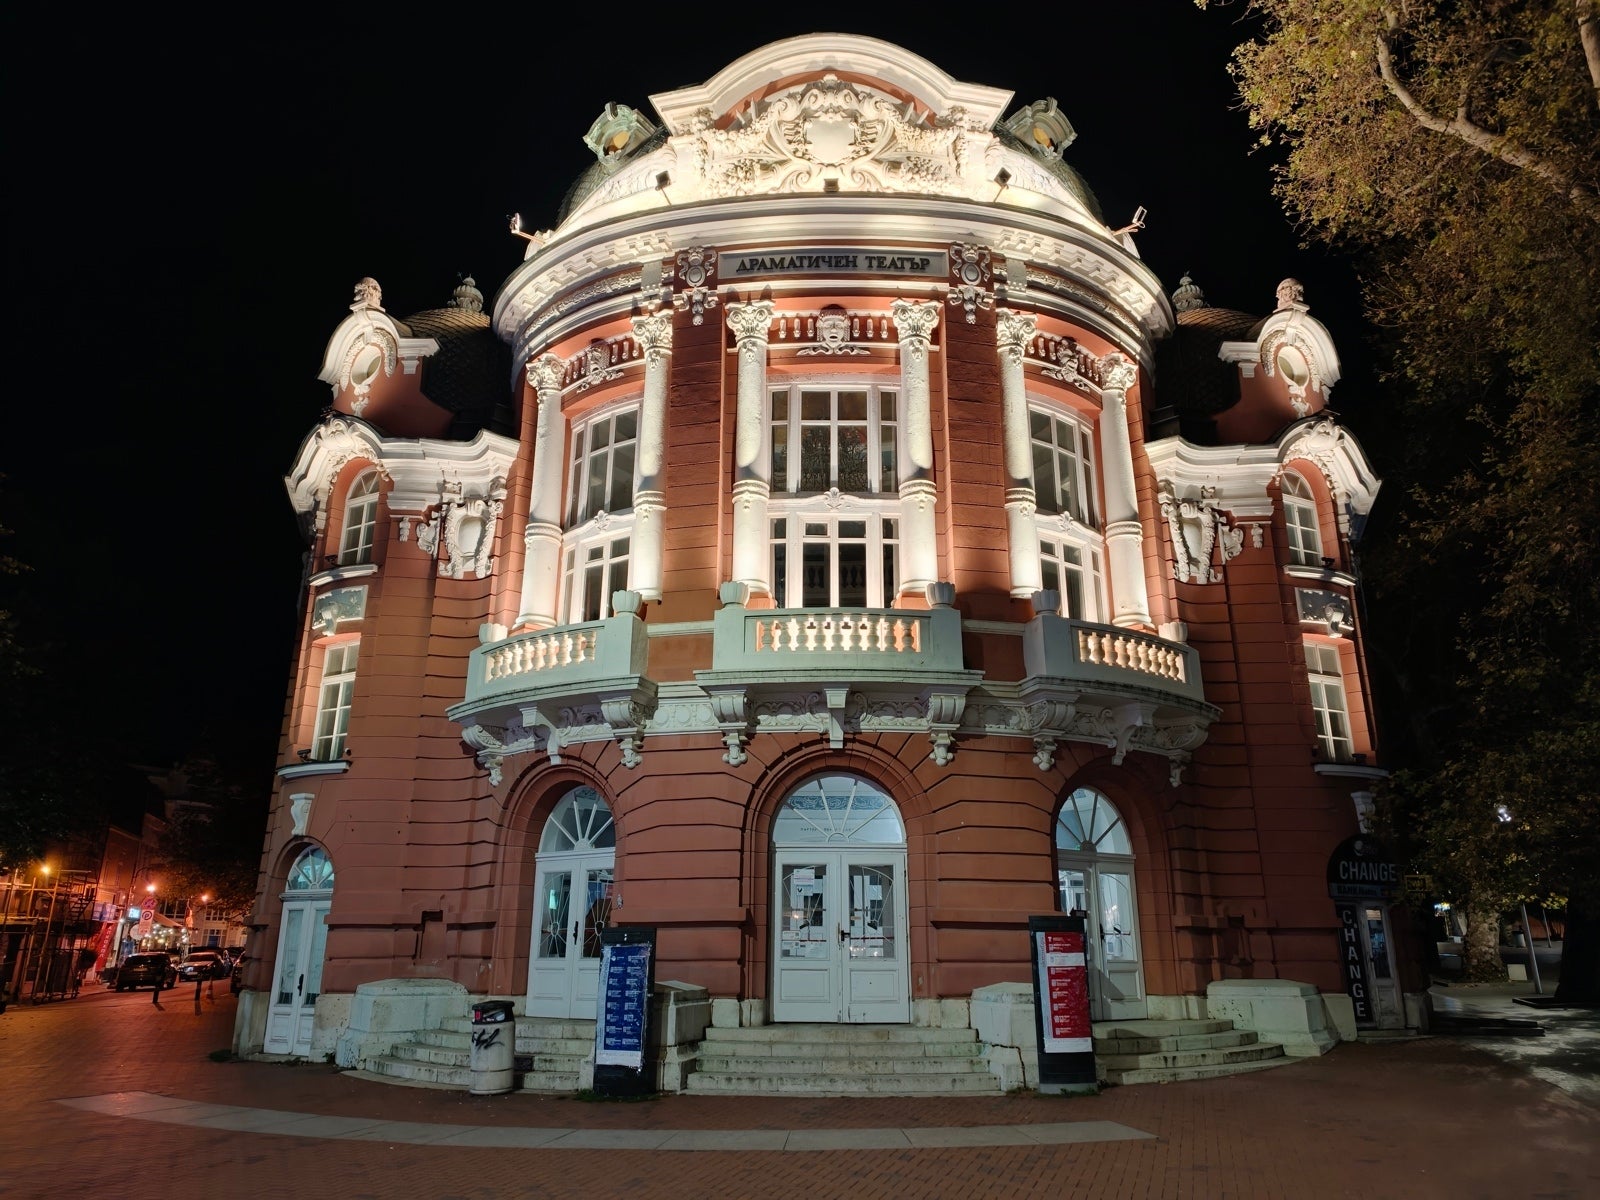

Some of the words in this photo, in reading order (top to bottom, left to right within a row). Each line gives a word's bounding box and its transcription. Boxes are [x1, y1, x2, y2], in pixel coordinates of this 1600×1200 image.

[736, 255, 858, 272] ДРАМАТИЧЕН
[865, 255, 931, 270] ТЕАТЪР
[1339, 860, 1397, 882] CHANGE
[1342, 910, 1366, 1017] CHANGE
